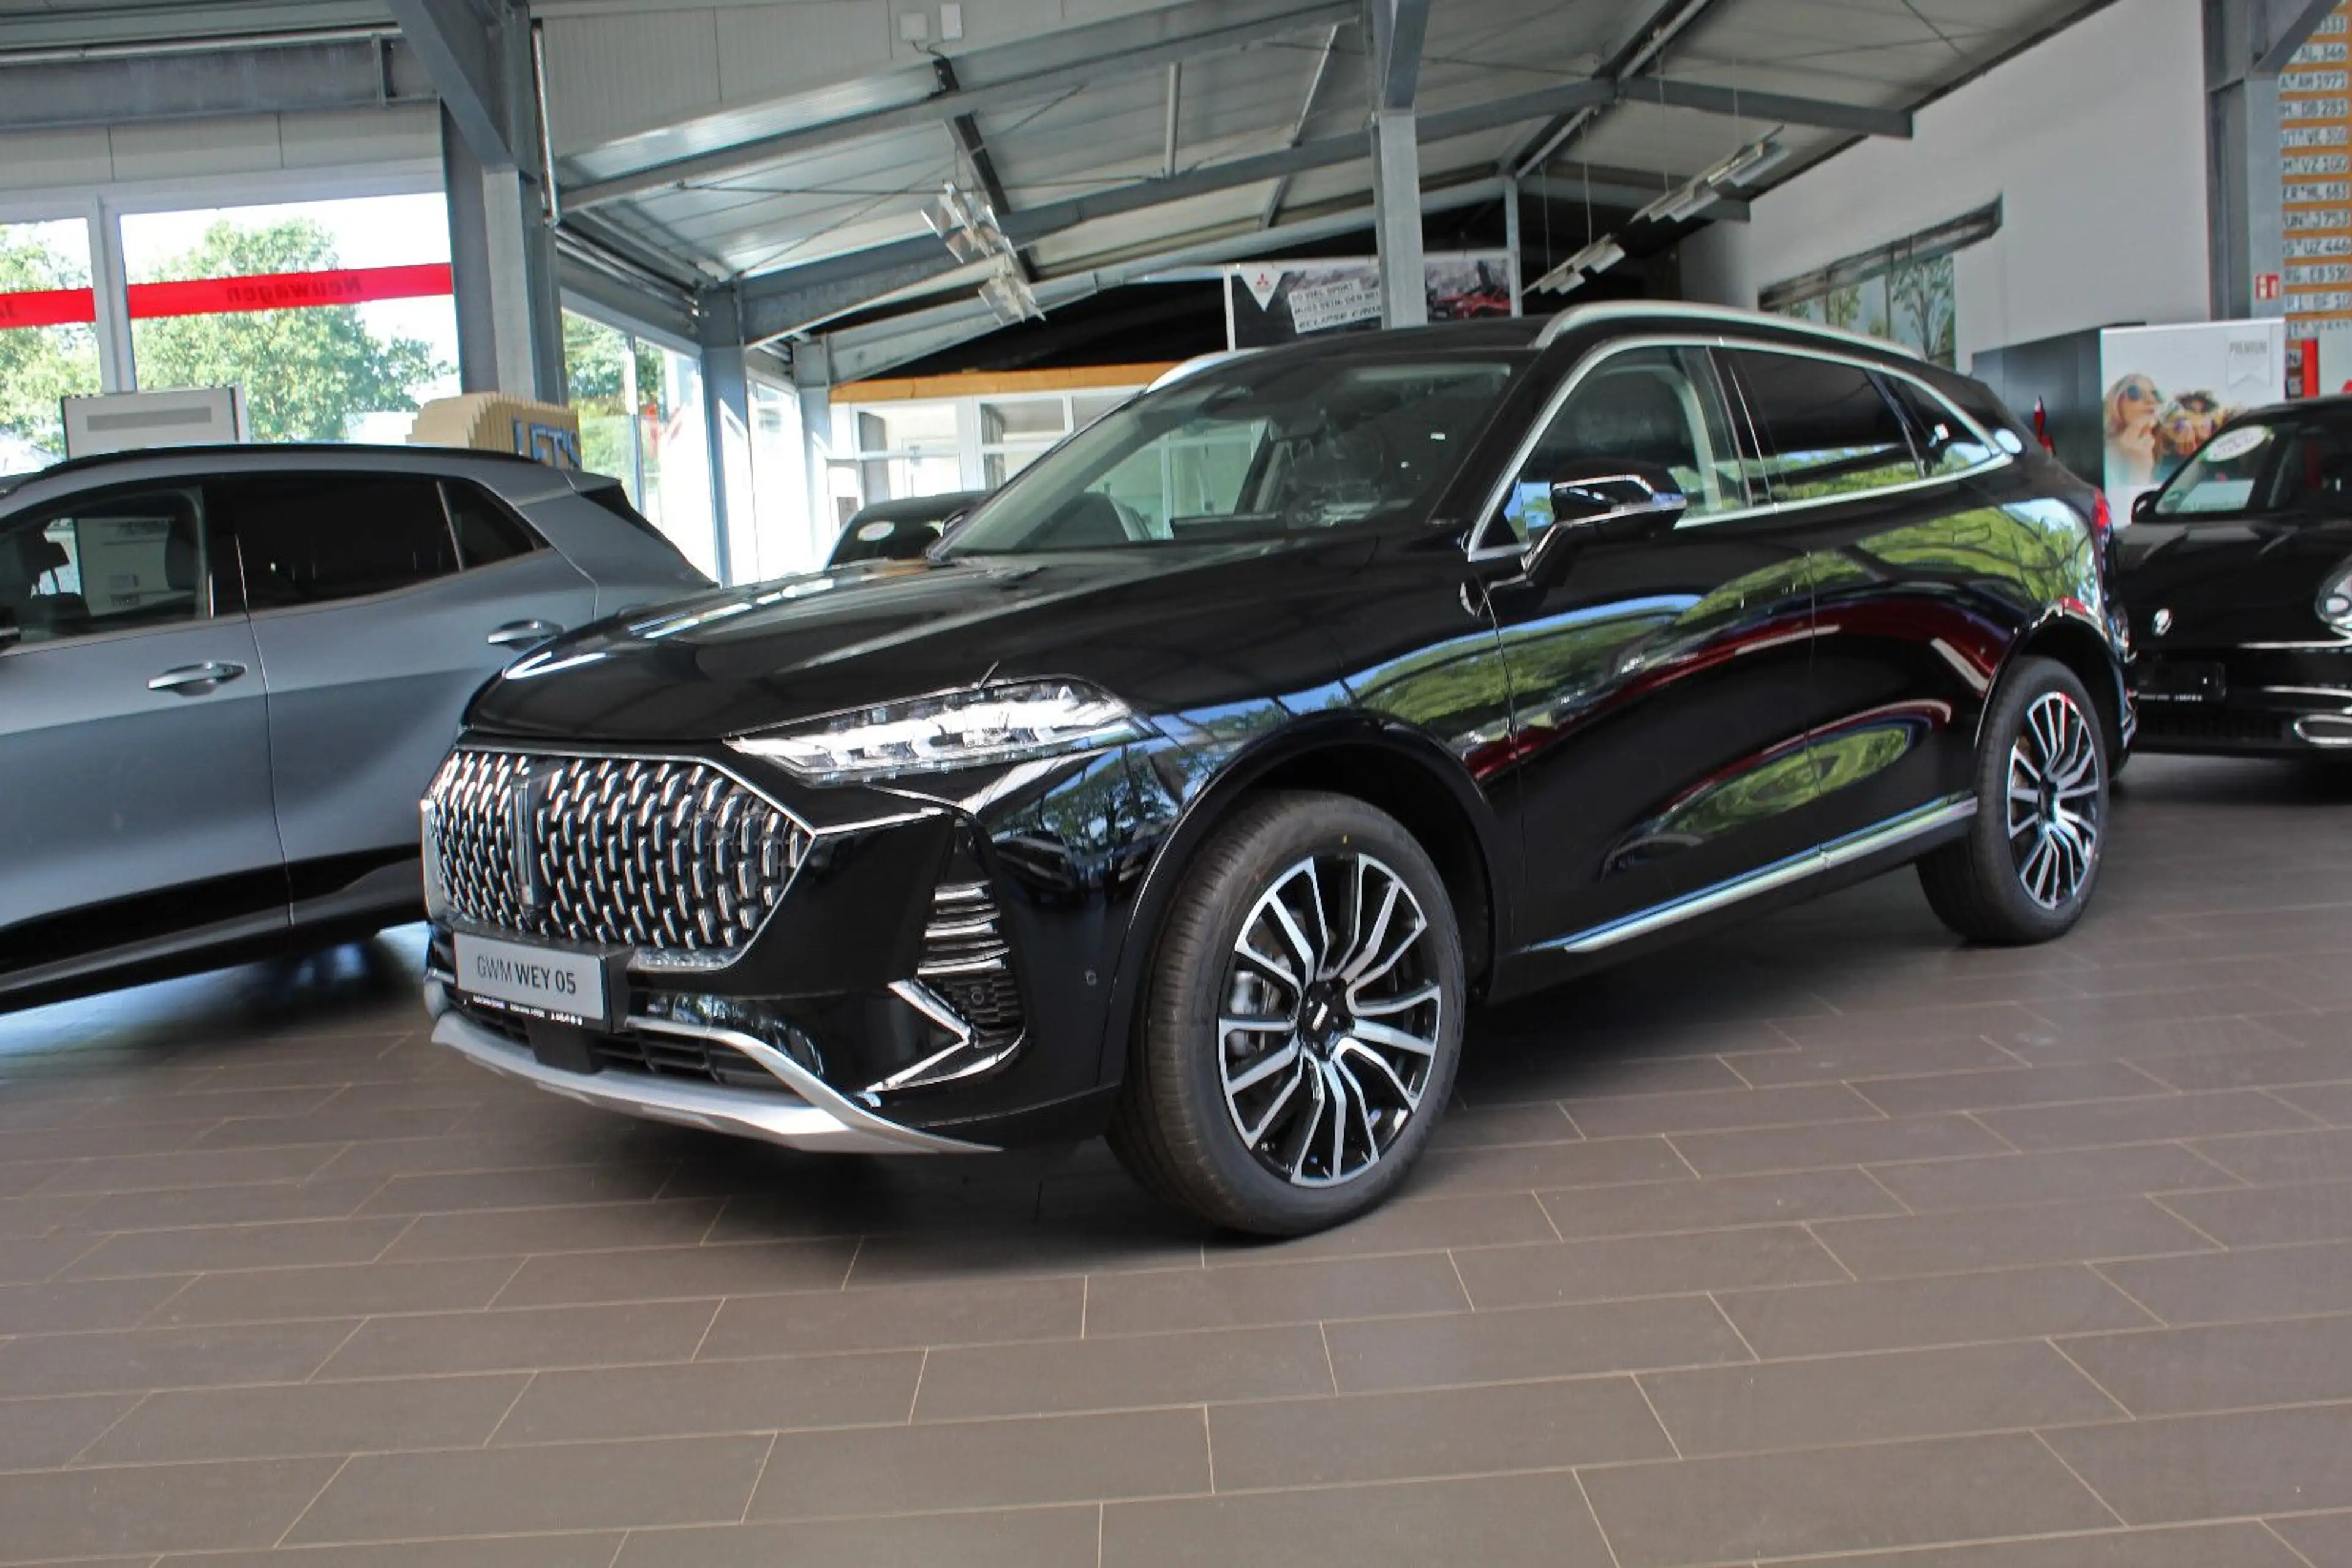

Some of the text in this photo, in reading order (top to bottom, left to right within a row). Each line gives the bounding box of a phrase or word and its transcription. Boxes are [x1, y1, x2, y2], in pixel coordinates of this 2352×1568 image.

[477, 955, 577, 995] GWM WEY 05
